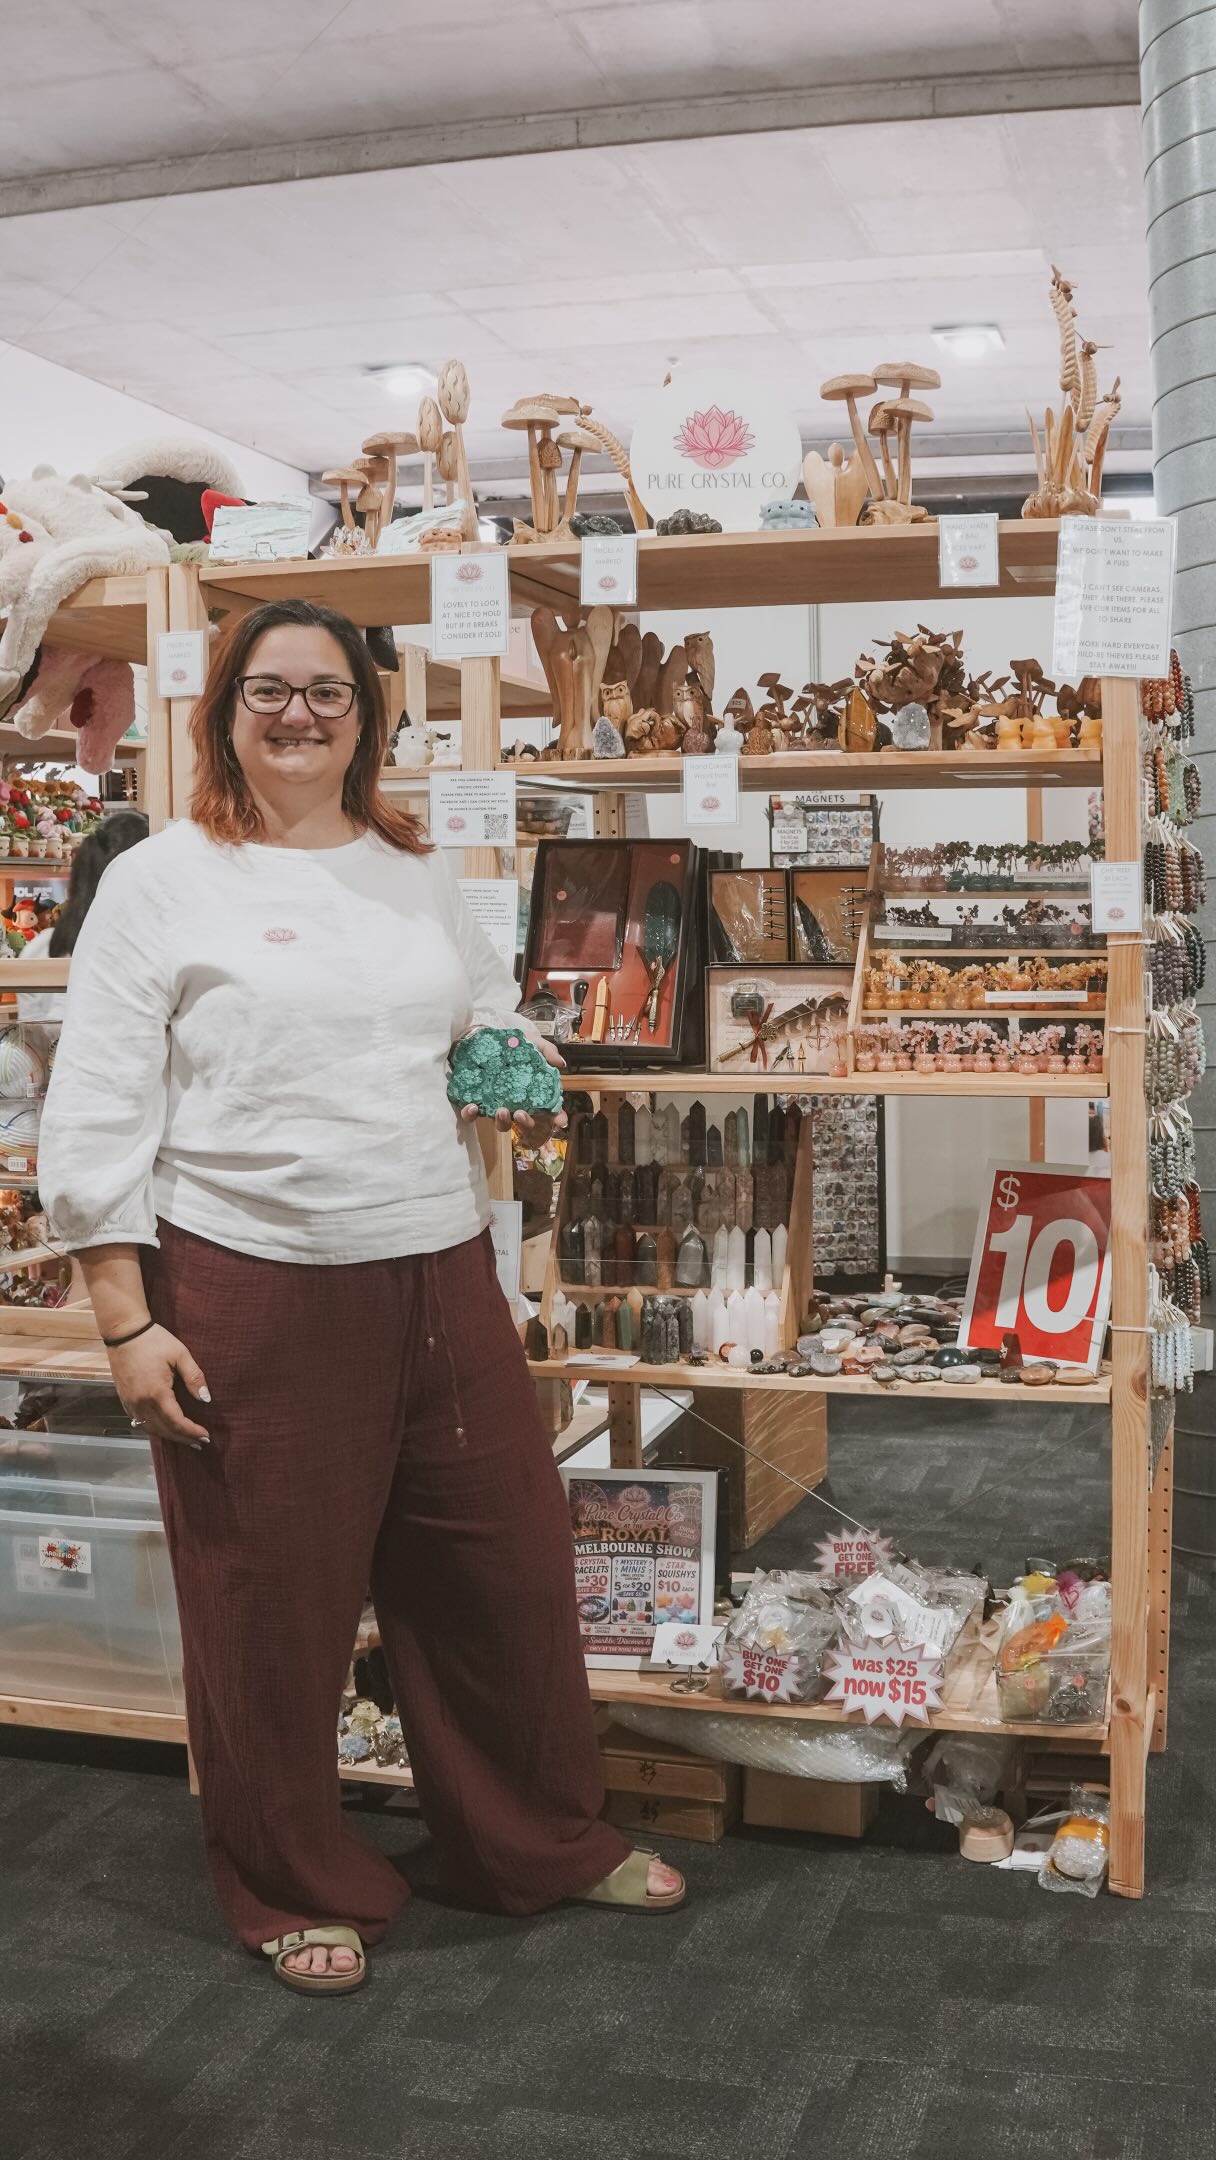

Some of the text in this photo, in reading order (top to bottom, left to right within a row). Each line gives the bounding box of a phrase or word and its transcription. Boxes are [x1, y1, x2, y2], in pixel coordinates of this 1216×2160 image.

[648, 471, 788, 490] PURE CRYSTAL CO.
[1074, 524, 1165, 535] PLEASE DON'T STEAL FROM
[1110, 549, 1130, 557] WANT
[443, 599, 500, 609] LOVELY TO LOOK
[1082, 594, 1099, 602] THEY
[1140, 596, 1165, 604] PLEASE
[454, 610, 471, 619] NICE
[482, 609, 502, 617] HOLD
[1132, 606, 1146, 614] FOR
[446, 620, 498, 630] BUT IF IT BREAKS
[440, 631, 476, 640] CONSIDER
[478, 631, 483, 639] IT
[485, 630, 502, 639] SOLD
[1079, 640, 1100, 648] WORK
[1102, 641, 1122, 649] HARD
[1124, 642, 1160, 650] EVERYDAY
[1075, 651, 1160, 661] OULD-BE THIEVES PLEASE
[1089, 661, 1106, 669] STAY
[795, 794, 846, 803] MAGNETS
[989, 1174, 1099, 1334] $ 10
[585, 1502, 685, 1524] Pure Crystal Co.
[600, 1526, 670, 1543] ROYAL
[574, 1542, 695, 1558] MELBOURNE SHOW
[834, 1541, 854, 1553] BUY
[580, 1558, 608, 1566] CRYSTAL
[838, 1552, 873, 1562] GET ONE
[575, 1565, 610, 1574] RACELETS
[620, 1565, 647, 1574] MINIS
[665, 1561, 686, 1569] STAR
[835, 1561, 876, 1577] FREE
[657, 1569, 697, 1579] SQUISHYS
[585, 1575, 608, 1587] $30
[614, 1581, 622, 1591] 5
[631, 1581, 652, 1592] $20
[658, 1580, 681, 1593] $10
[616, 1636, 644, 1646] Discover
[742, 1650, 788, 1670] BUY ONE
[744, 1660, 785, 1677] GET ONE
[852, 1657, 918, 1677] was $25
[742, 1670, 780, 1692] $10
[843, 1676, 927, 1705] now $15
